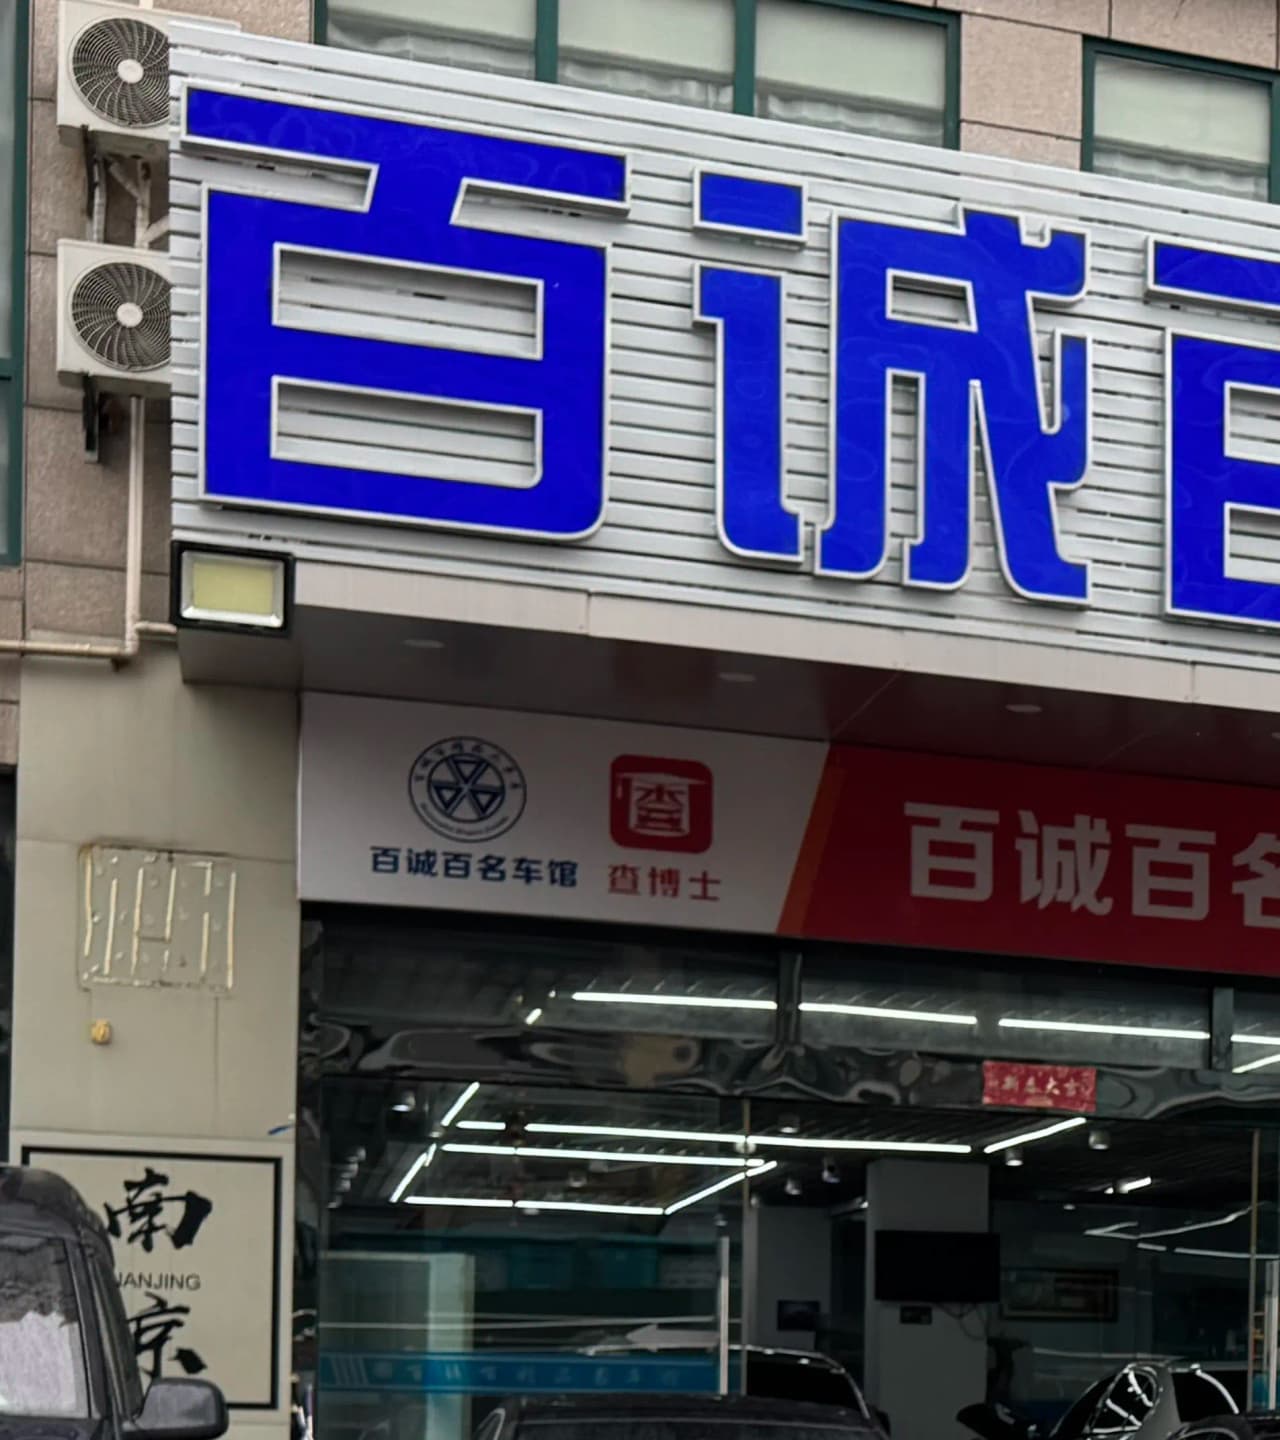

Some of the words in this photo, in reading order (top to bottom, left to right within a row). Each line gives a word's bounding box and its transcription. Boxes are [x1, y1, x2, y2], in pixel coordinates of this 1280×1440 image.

[370, 846, 578, 888] 百诚百名车馆
[608, 863, 721, 902] 查博士
[105, 1167, 213, 1252] 南
